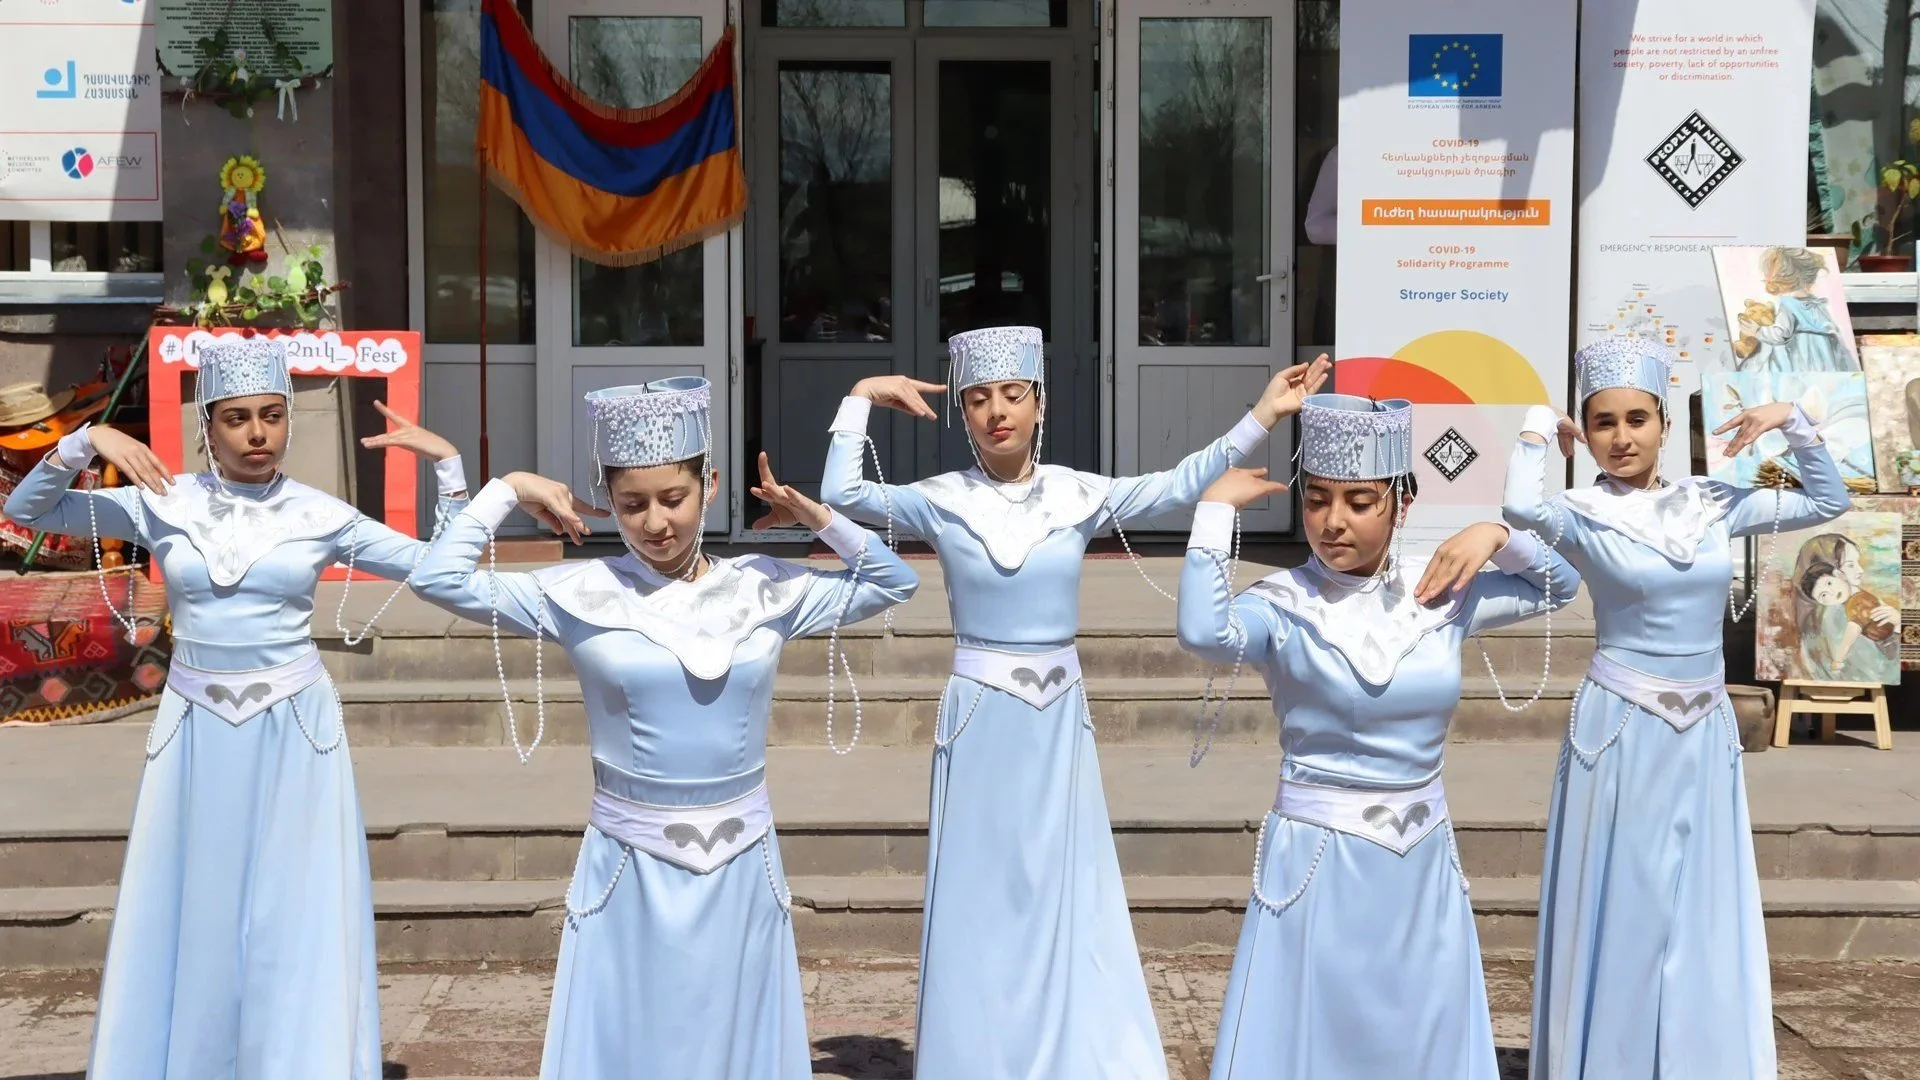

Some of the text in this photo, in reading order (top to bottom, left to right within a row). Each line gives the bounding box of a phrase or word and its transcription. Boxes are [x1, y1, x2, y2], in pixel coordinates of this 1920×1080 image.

[1631, 34, 1646, 43] We
[1648, 34, 1672, 43] strive
[1675, 34, 1688, 43] for
[1698, 34, 1724, 43] world
[1726, 34, 1734, 43] in
[1736, 34, 1763, 43] which
[1613, 47, 1644, 57] people
[1663, 48, 1677, 56] not
[1680, 47, 1722, 56] restricted
[1723, 47, 1734, 57] by
[1750, 46, 1779, 56] unfree
[1688, 59, 1705, 68] lack
[1708, 59, 1718, 68] of
[1719, 60, 1779, 70] opportunities
[1659, 72, 1734, 81] or discrimination.
[84, 88, 139, 99] ՀԱՅԱՍՏԱՆ
[1432, 139, 1480, 148] COVID-19
[1651, 116, 1732, 166] PEOPLE IN NEED
[97, 156, 142, 166] AFEW
[1691, 158, 1739, 204] REPUBLIC
[1373, 207, 1539, 220] Ուժեղ հասարակություն
[1428, 246, 1476, 254] COVID-19
[1600, 244, 1652, 253] EMERGENCY
[1654, 244, 1698, 253] RESPONSE
[1397, 259, 1510, 270] Solidarity Programme
[1399, 289, 1509, 303] Stronger Society
[360, 347, 398, 363] Fest
[1426, 430, 1472, 458] PEOPLE IN NEED
